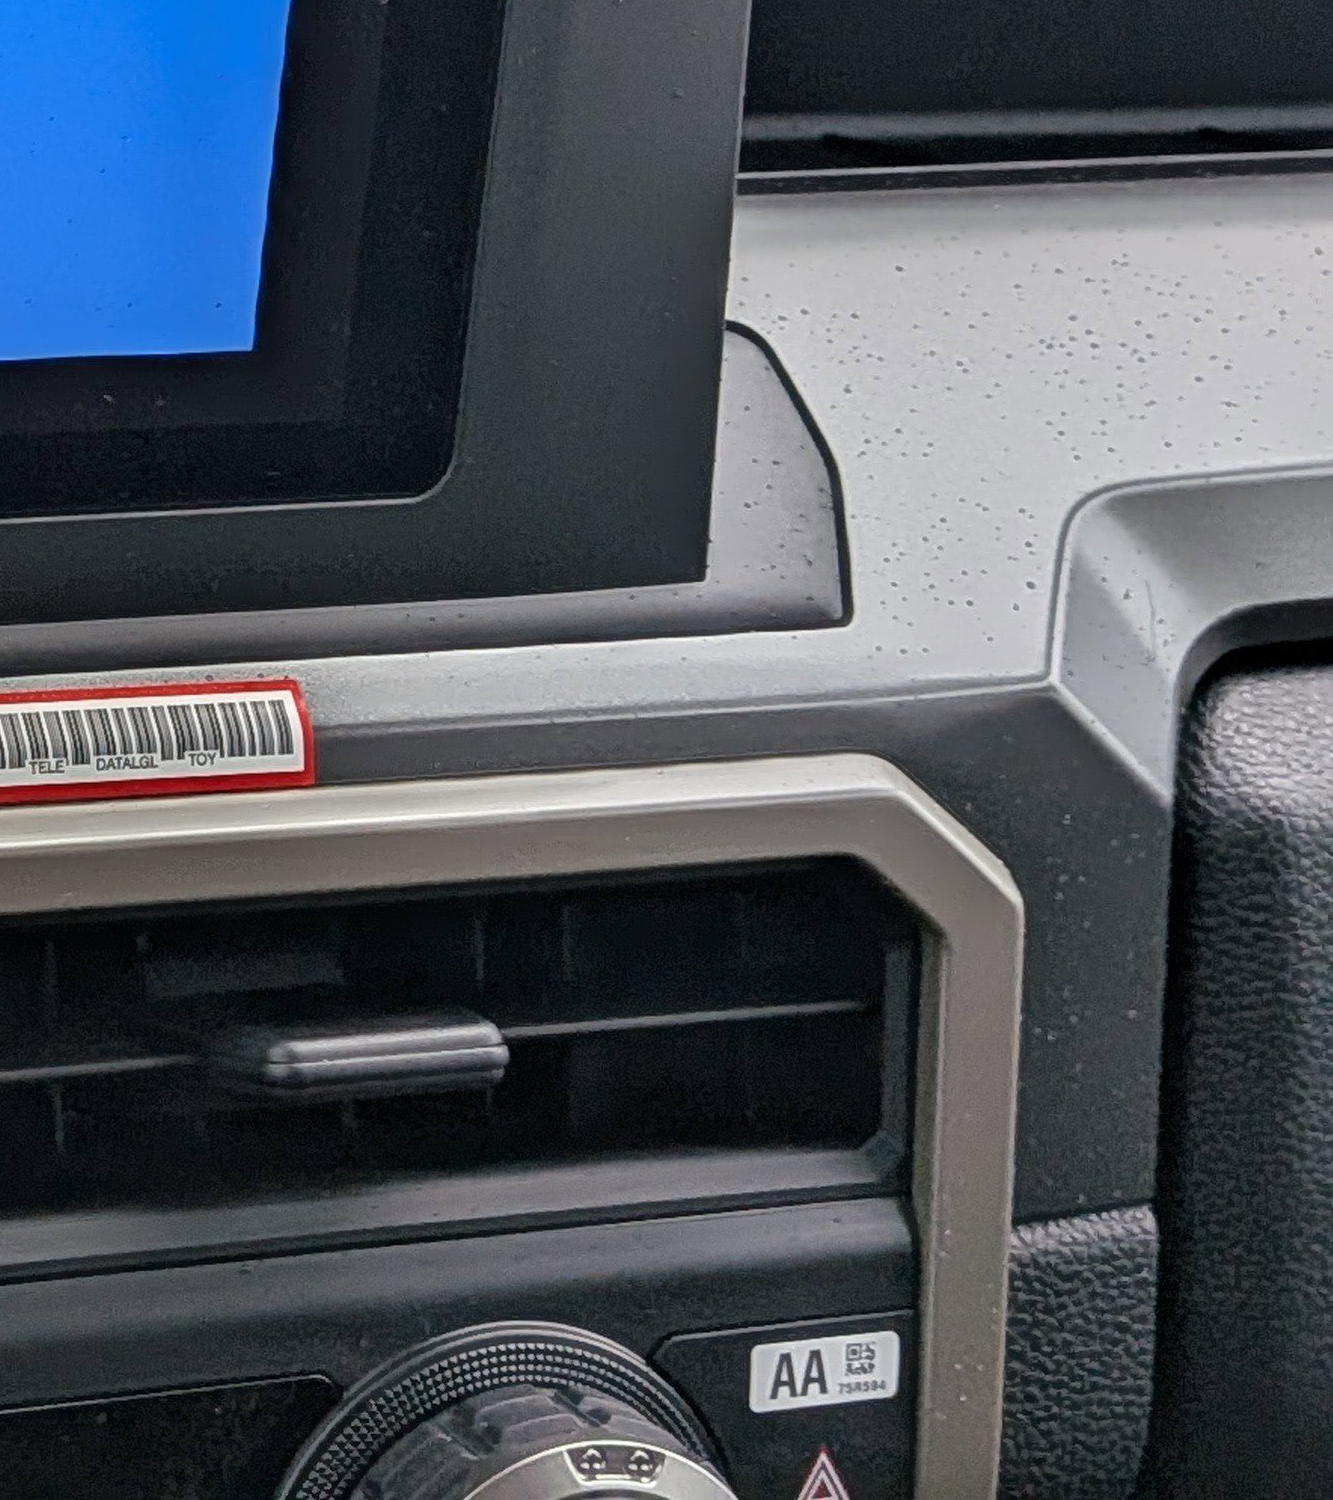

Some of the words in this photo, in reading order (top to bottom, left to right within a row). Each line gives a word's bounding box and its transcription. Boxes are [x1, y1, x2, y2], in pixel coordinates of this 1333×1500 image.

[28, 760, 65, 775] TELE
[95, 754, 159, 772] DATALGL
[188, 752, 217, 768] TOY
[769, 1348, 829, 1400] AA
